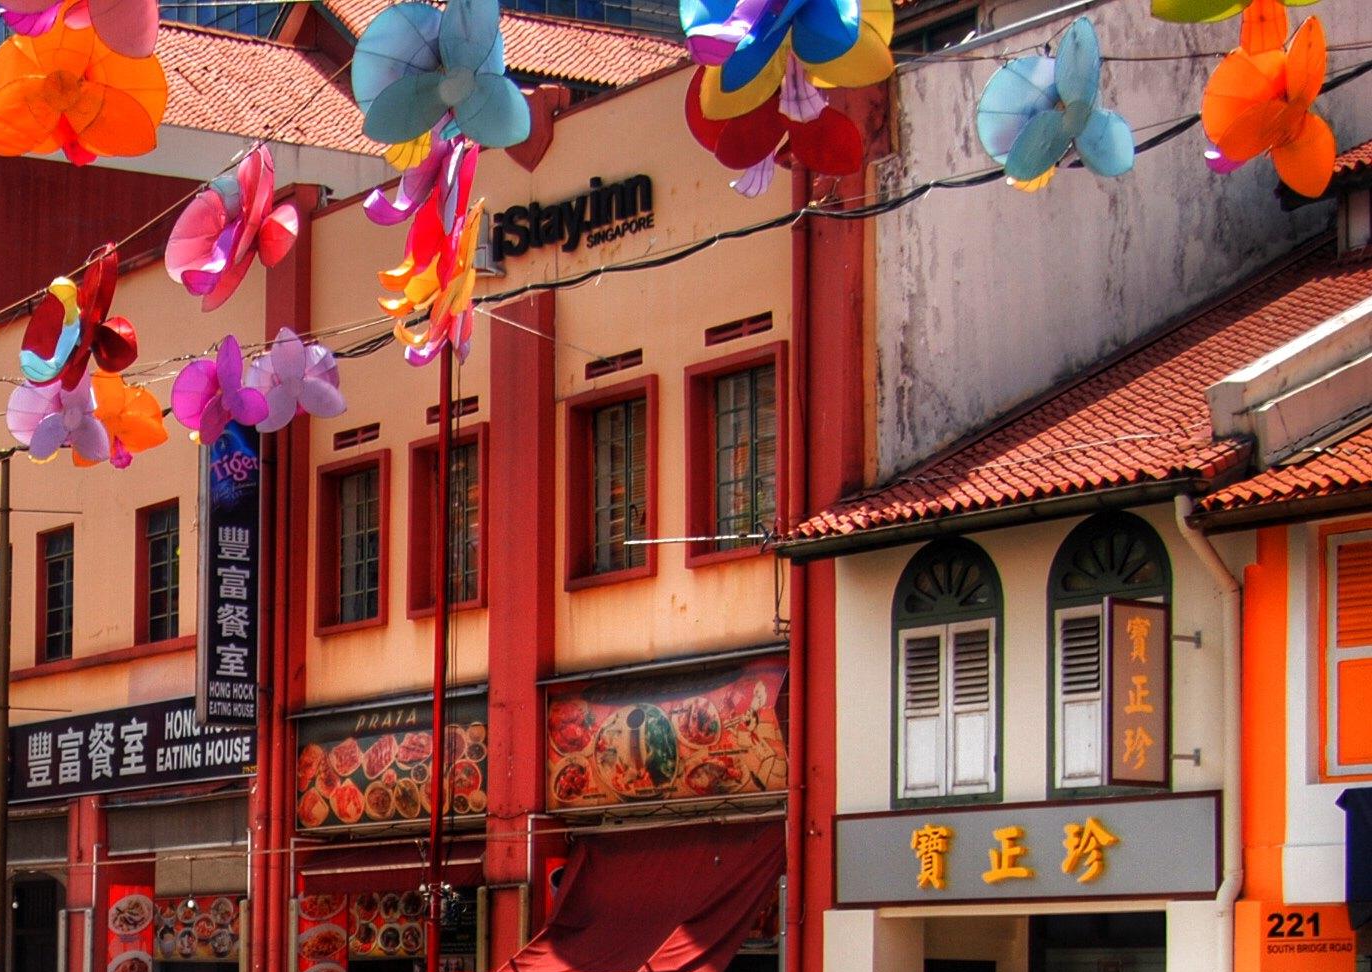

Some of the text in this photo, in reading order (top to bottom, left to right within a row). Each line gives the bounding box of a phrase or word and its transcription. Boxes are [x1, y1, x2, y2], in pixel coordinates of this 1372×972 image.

[586, 214, 655, 249] SINGAPORE
[210, 451, 258, 481] Tiger
[216, 526, 250, 678] 豐富餐室
[209, 681, 255, 700] HONG HOCK
[209, 701, 255, 718] EATING HOUSE
[26, 717, 148, 788] 豐富餐室
[156, 736, 251, 772] EATING HOUSE
[911, 816, 1120, 890] 寶正珍
[1267, 912, 1320, 938] 221
[1267, 943, 1353, 954] SOUTH BRIDGE ROAD
